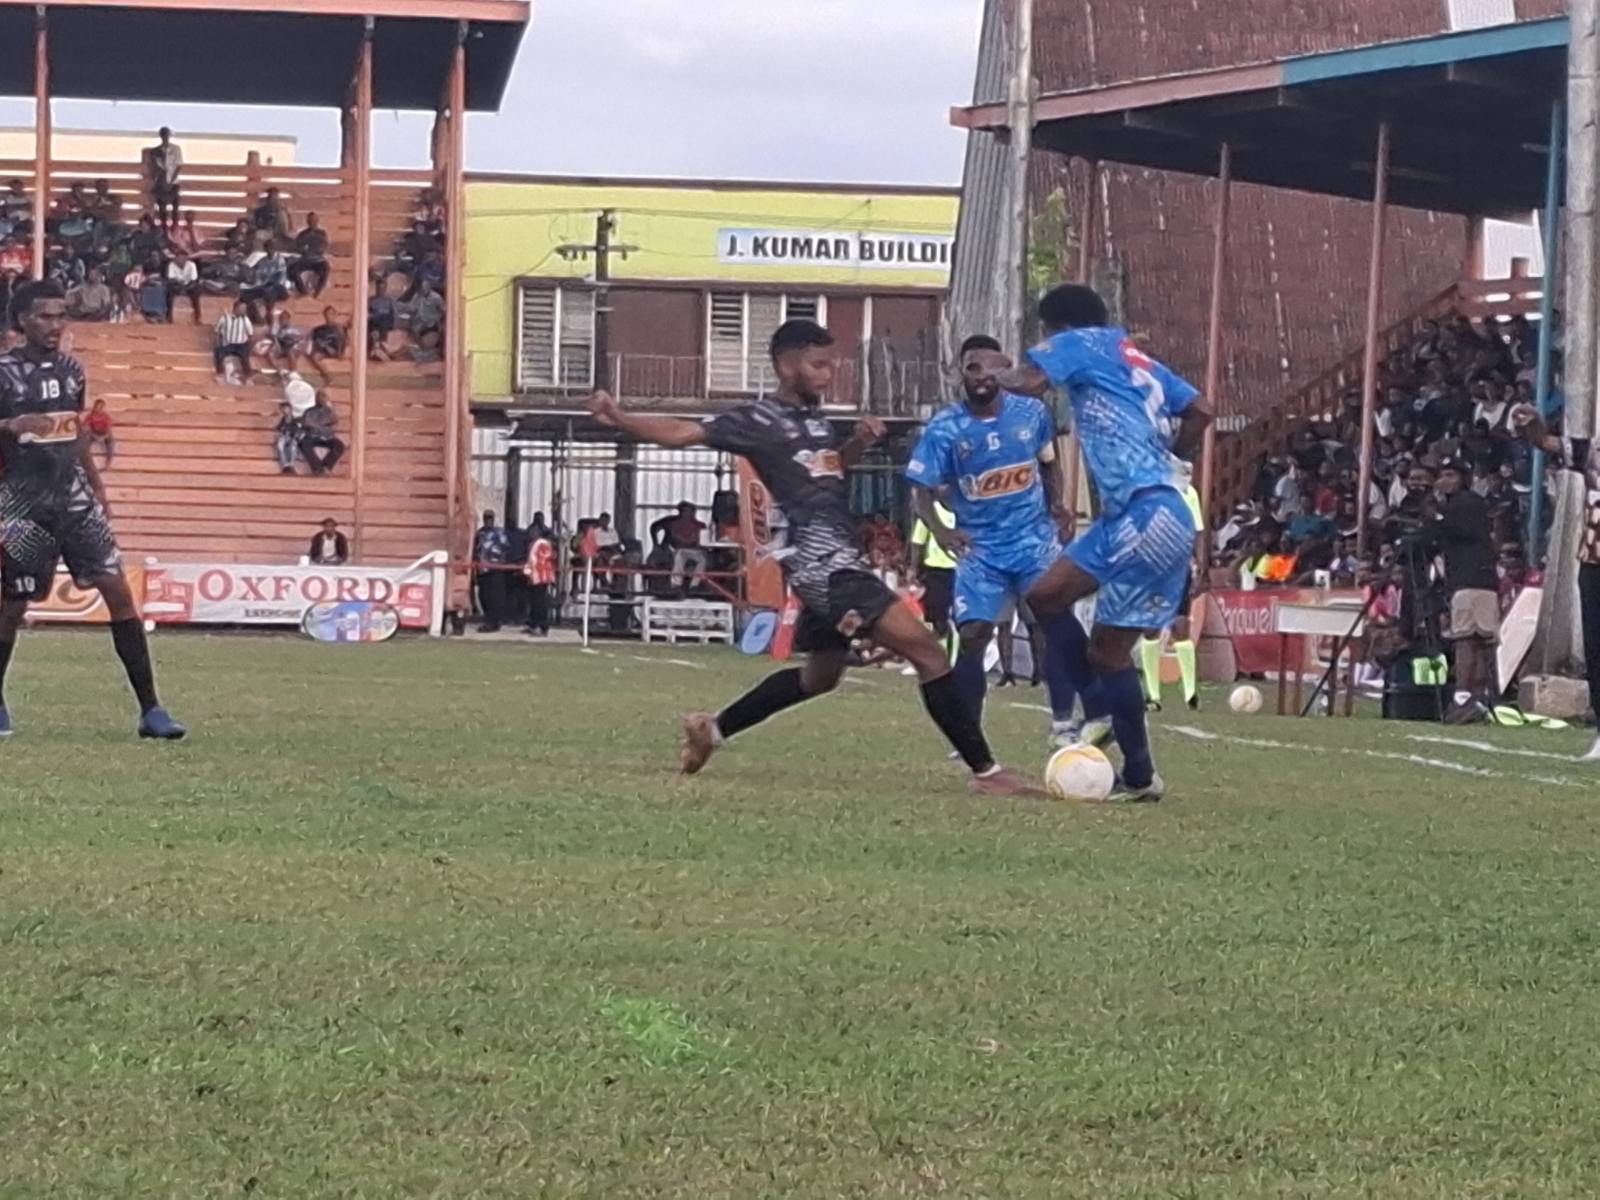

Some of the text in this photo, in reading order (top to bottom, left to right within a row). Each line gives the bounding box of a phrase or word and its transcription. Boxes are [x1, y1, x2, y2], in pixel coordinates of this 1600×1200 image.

[727, 234, 955, 264] J. KUMAR BUILDI
[199, 569, 394, 602] OXFORD
